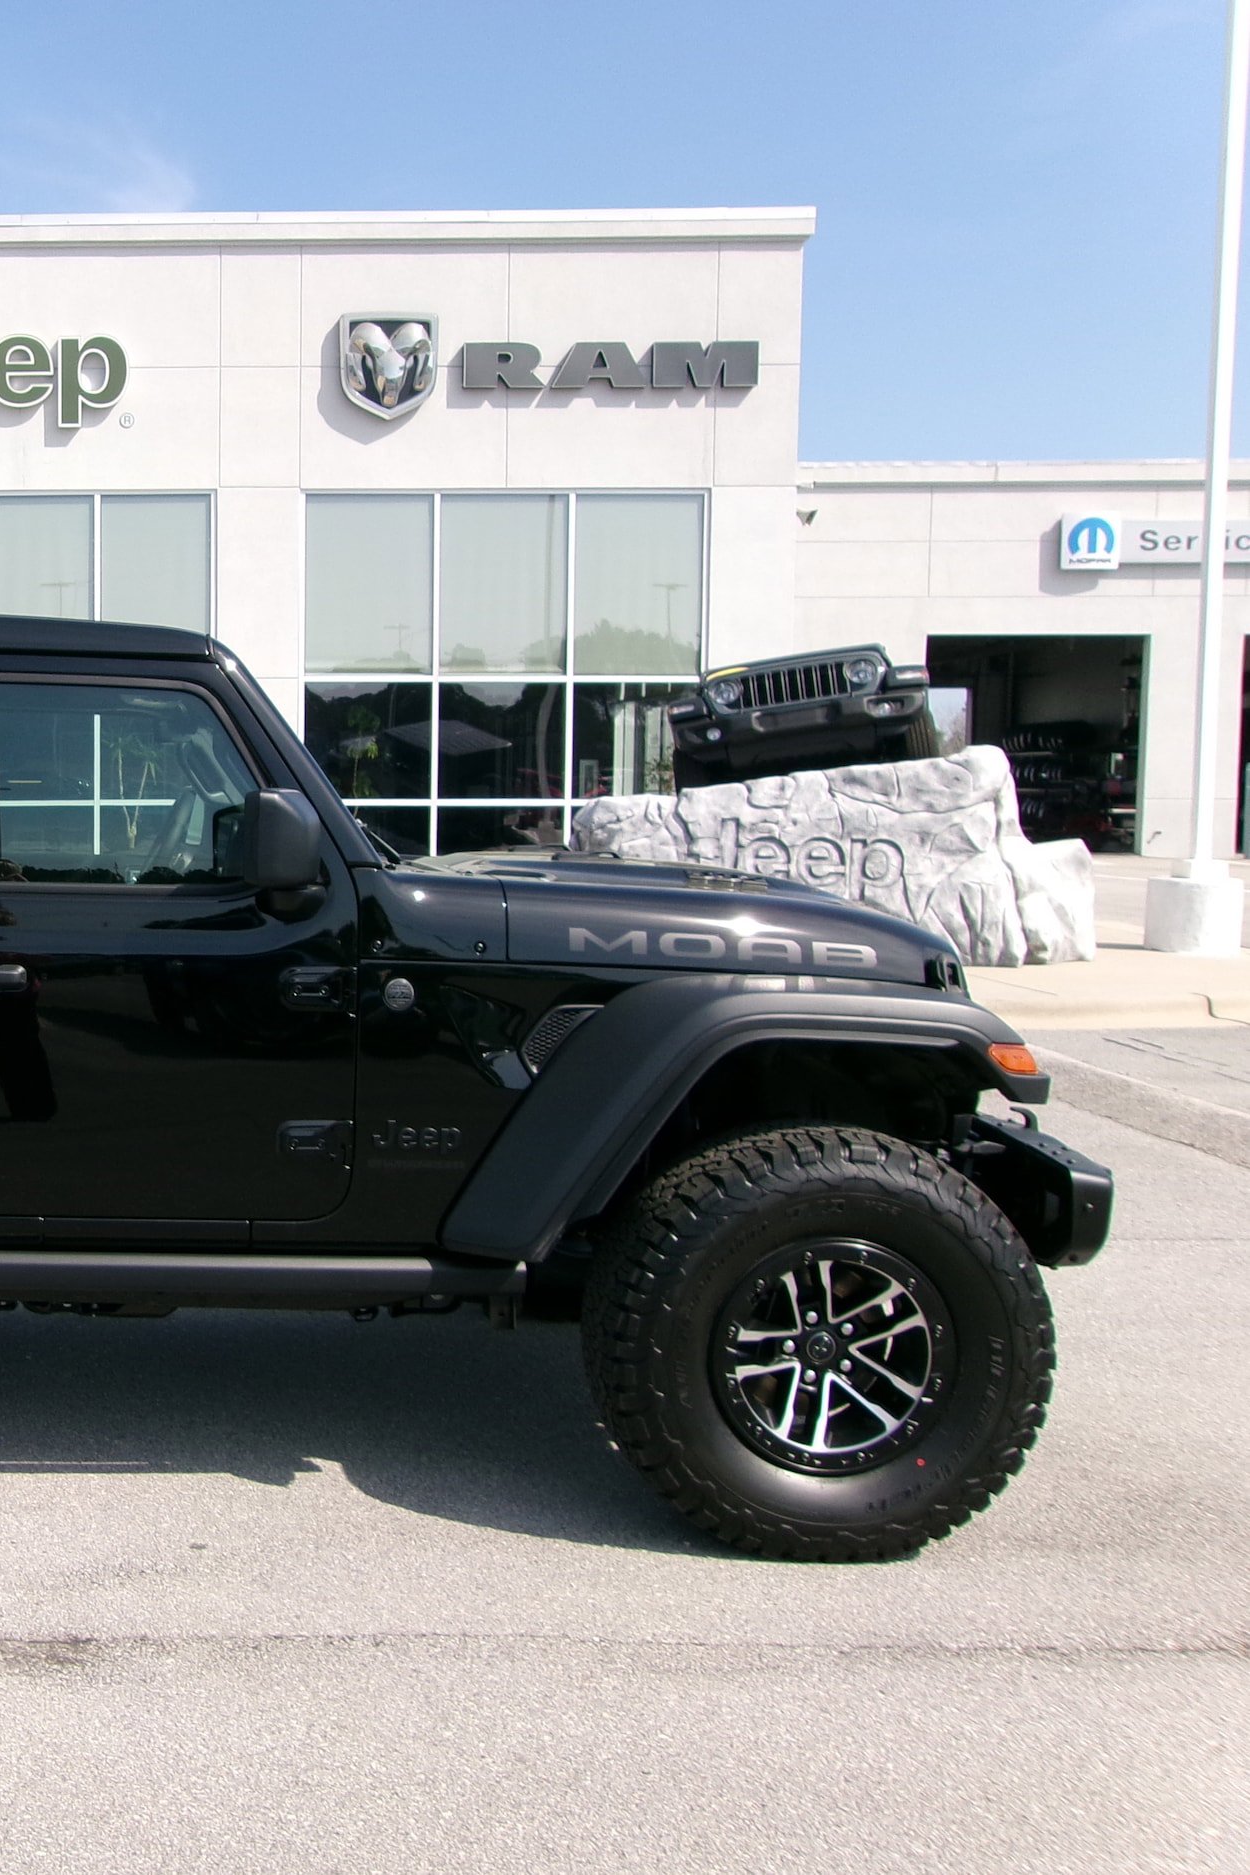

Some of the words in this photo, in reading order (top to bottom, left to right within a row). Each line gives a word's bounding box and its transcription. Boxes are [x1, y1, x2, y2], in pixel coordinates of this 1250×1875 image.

[462, 340, 759, 388] RAM
[1139, 529, 1250, 552] Seric
[688, 817, 905, 901] Jeep
[568, 926, 878, 969] MOAB
[372, 1118, 462, 1154] Jeep
